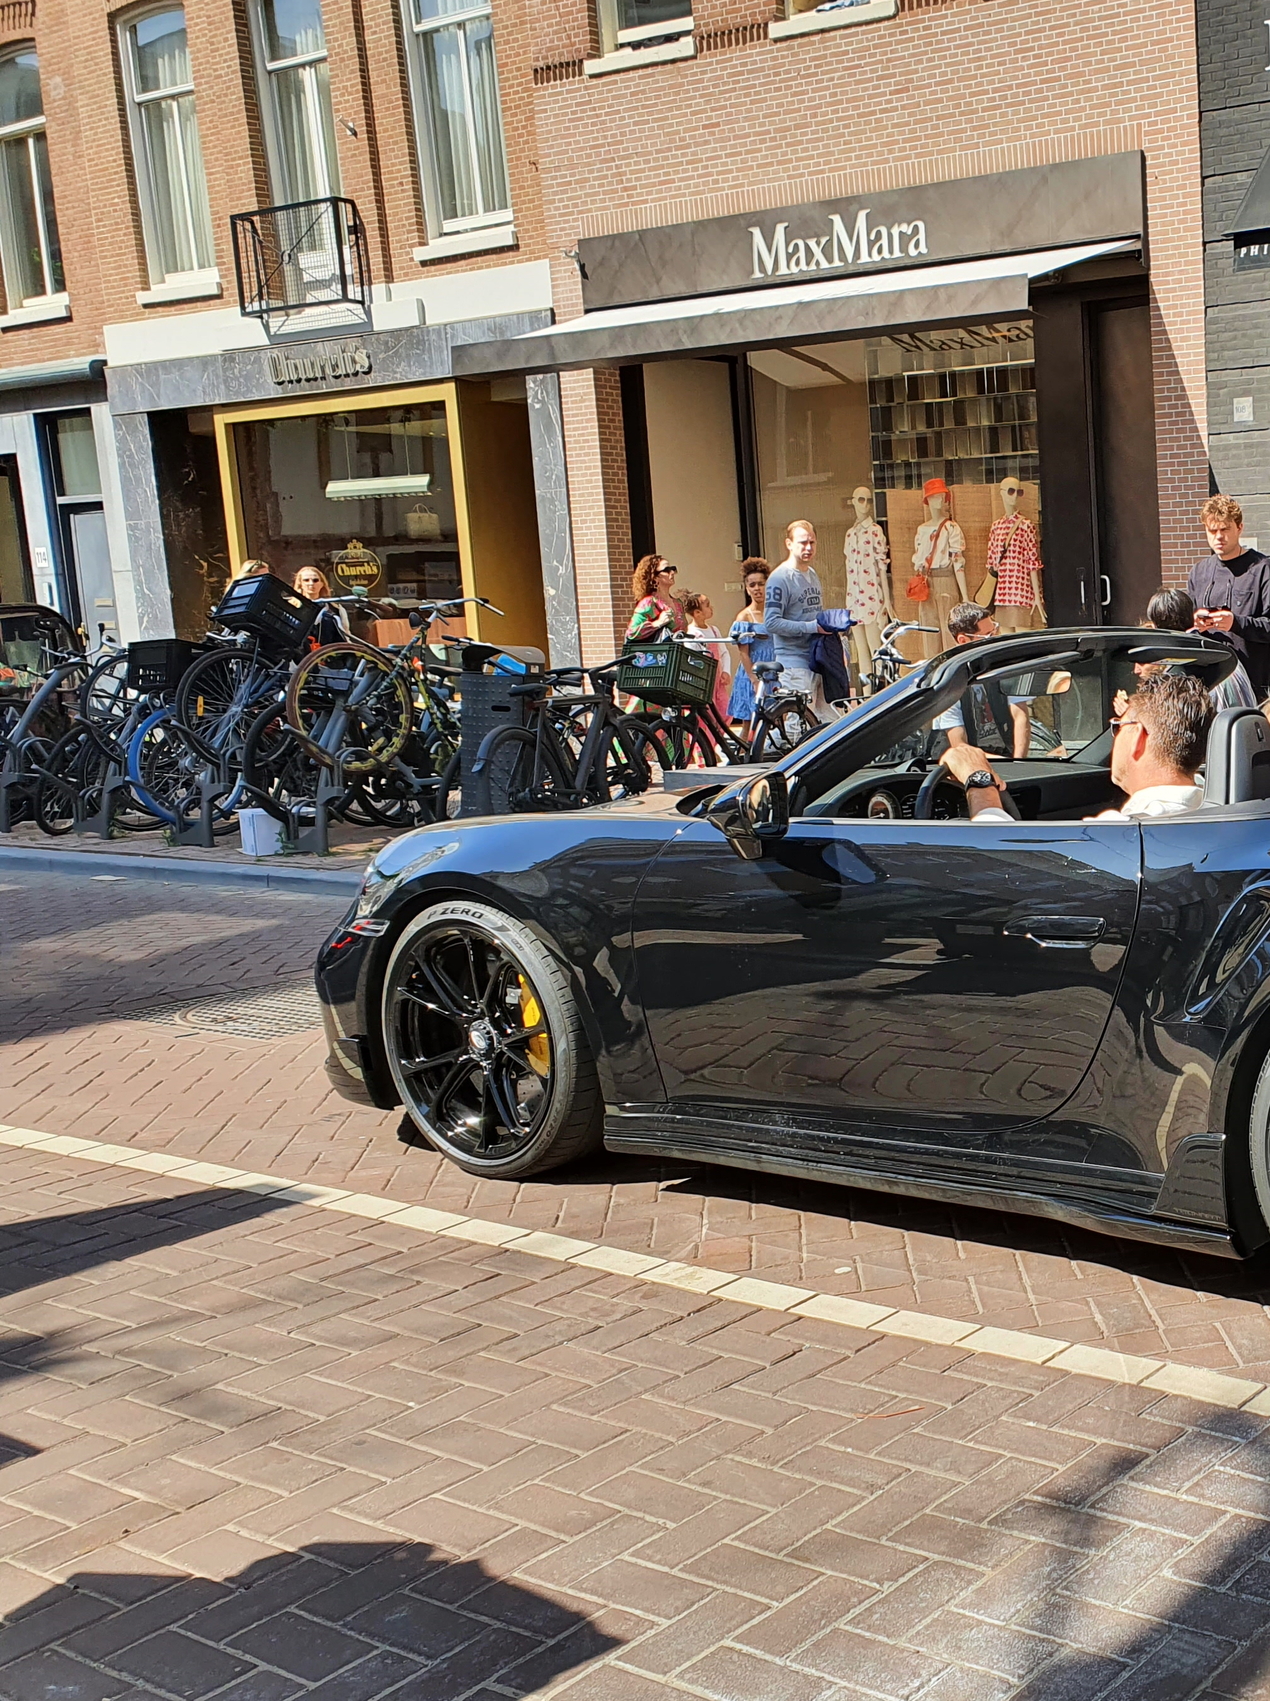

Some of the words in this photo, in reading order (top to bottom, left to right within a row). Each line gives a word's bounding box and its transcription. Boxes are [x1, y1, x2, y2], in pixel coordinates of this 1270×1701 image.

[747, 208, 928, 279] MaxMara
[36, 551, 48, 564] 114
[337, 562, 379, 576] Church's
[439, 907, 484, 919] ZERO
